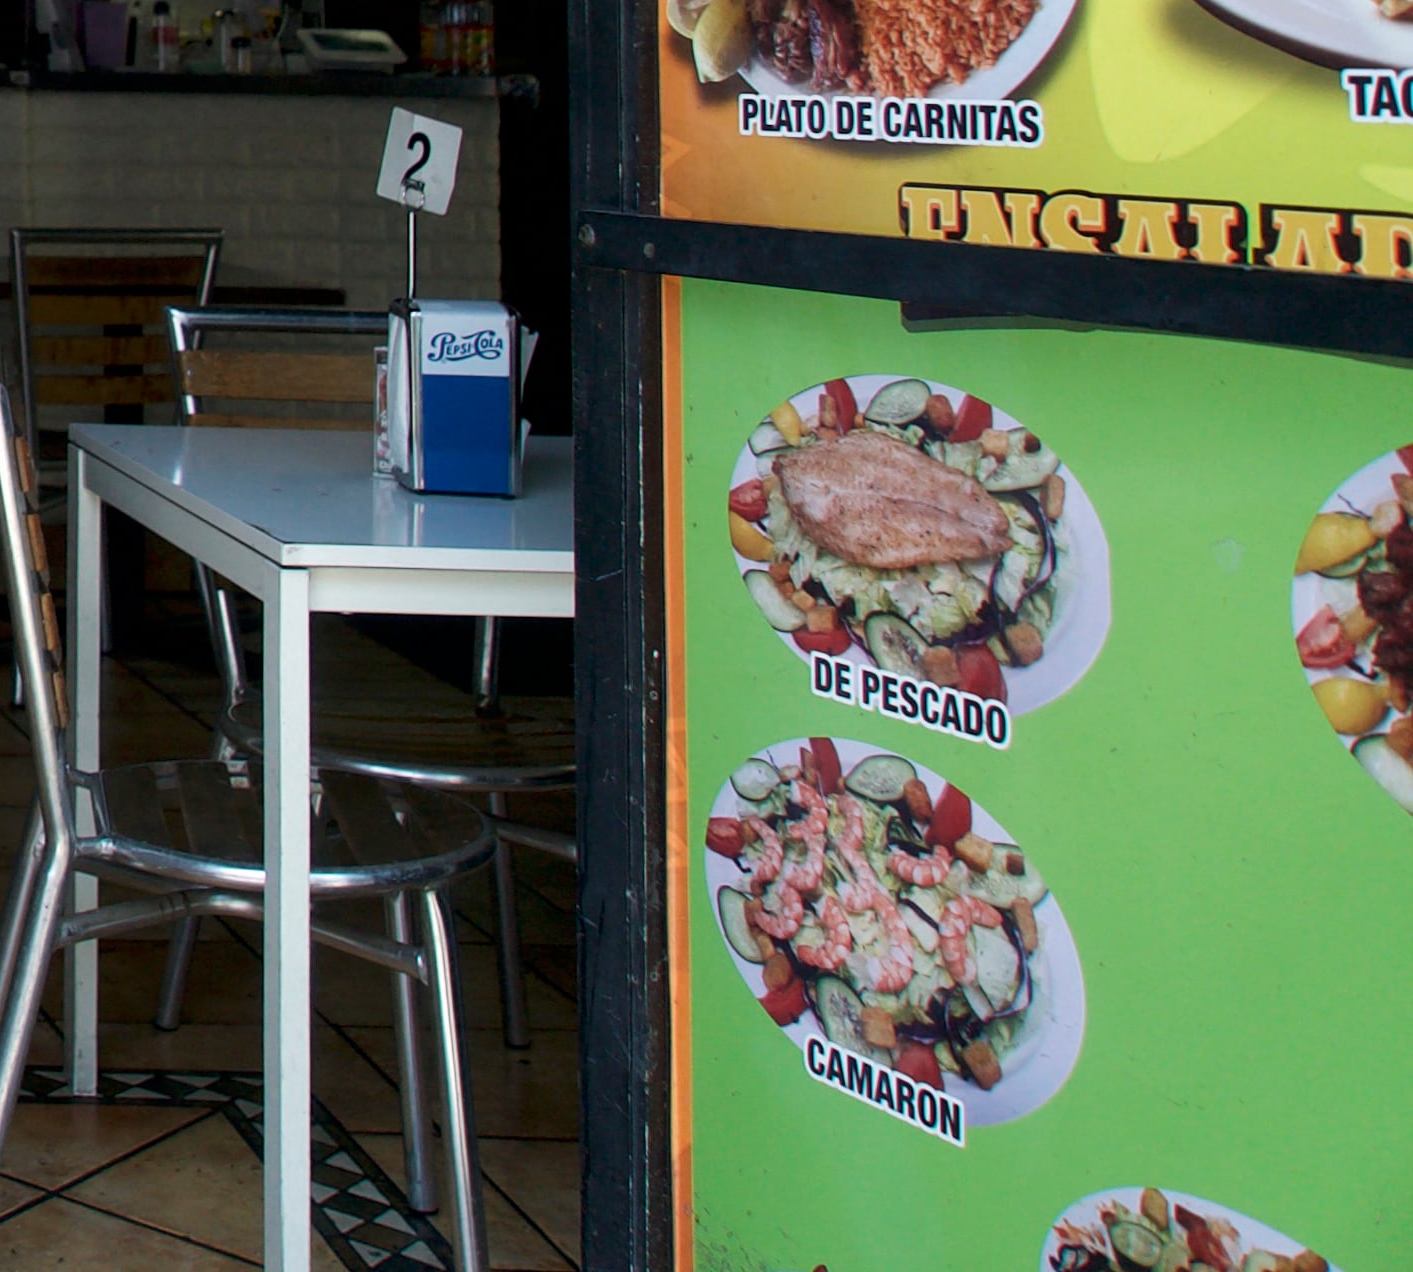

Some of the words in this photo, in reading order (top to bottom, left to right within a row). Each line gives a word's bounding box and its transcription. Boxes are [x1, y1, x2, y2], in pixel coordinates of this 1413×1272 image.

[742, 99, 826, 137] PLATO
[835, 99, 873, 138] DE
[882, 102, 1041, 143] CARNITAS
[402, 132, 431, 186] 2
[812, 655, 852, 700] DE
[862, 670, 1009, 745] PESCADO
[806, 1038, 963, 1142] CAMARON
